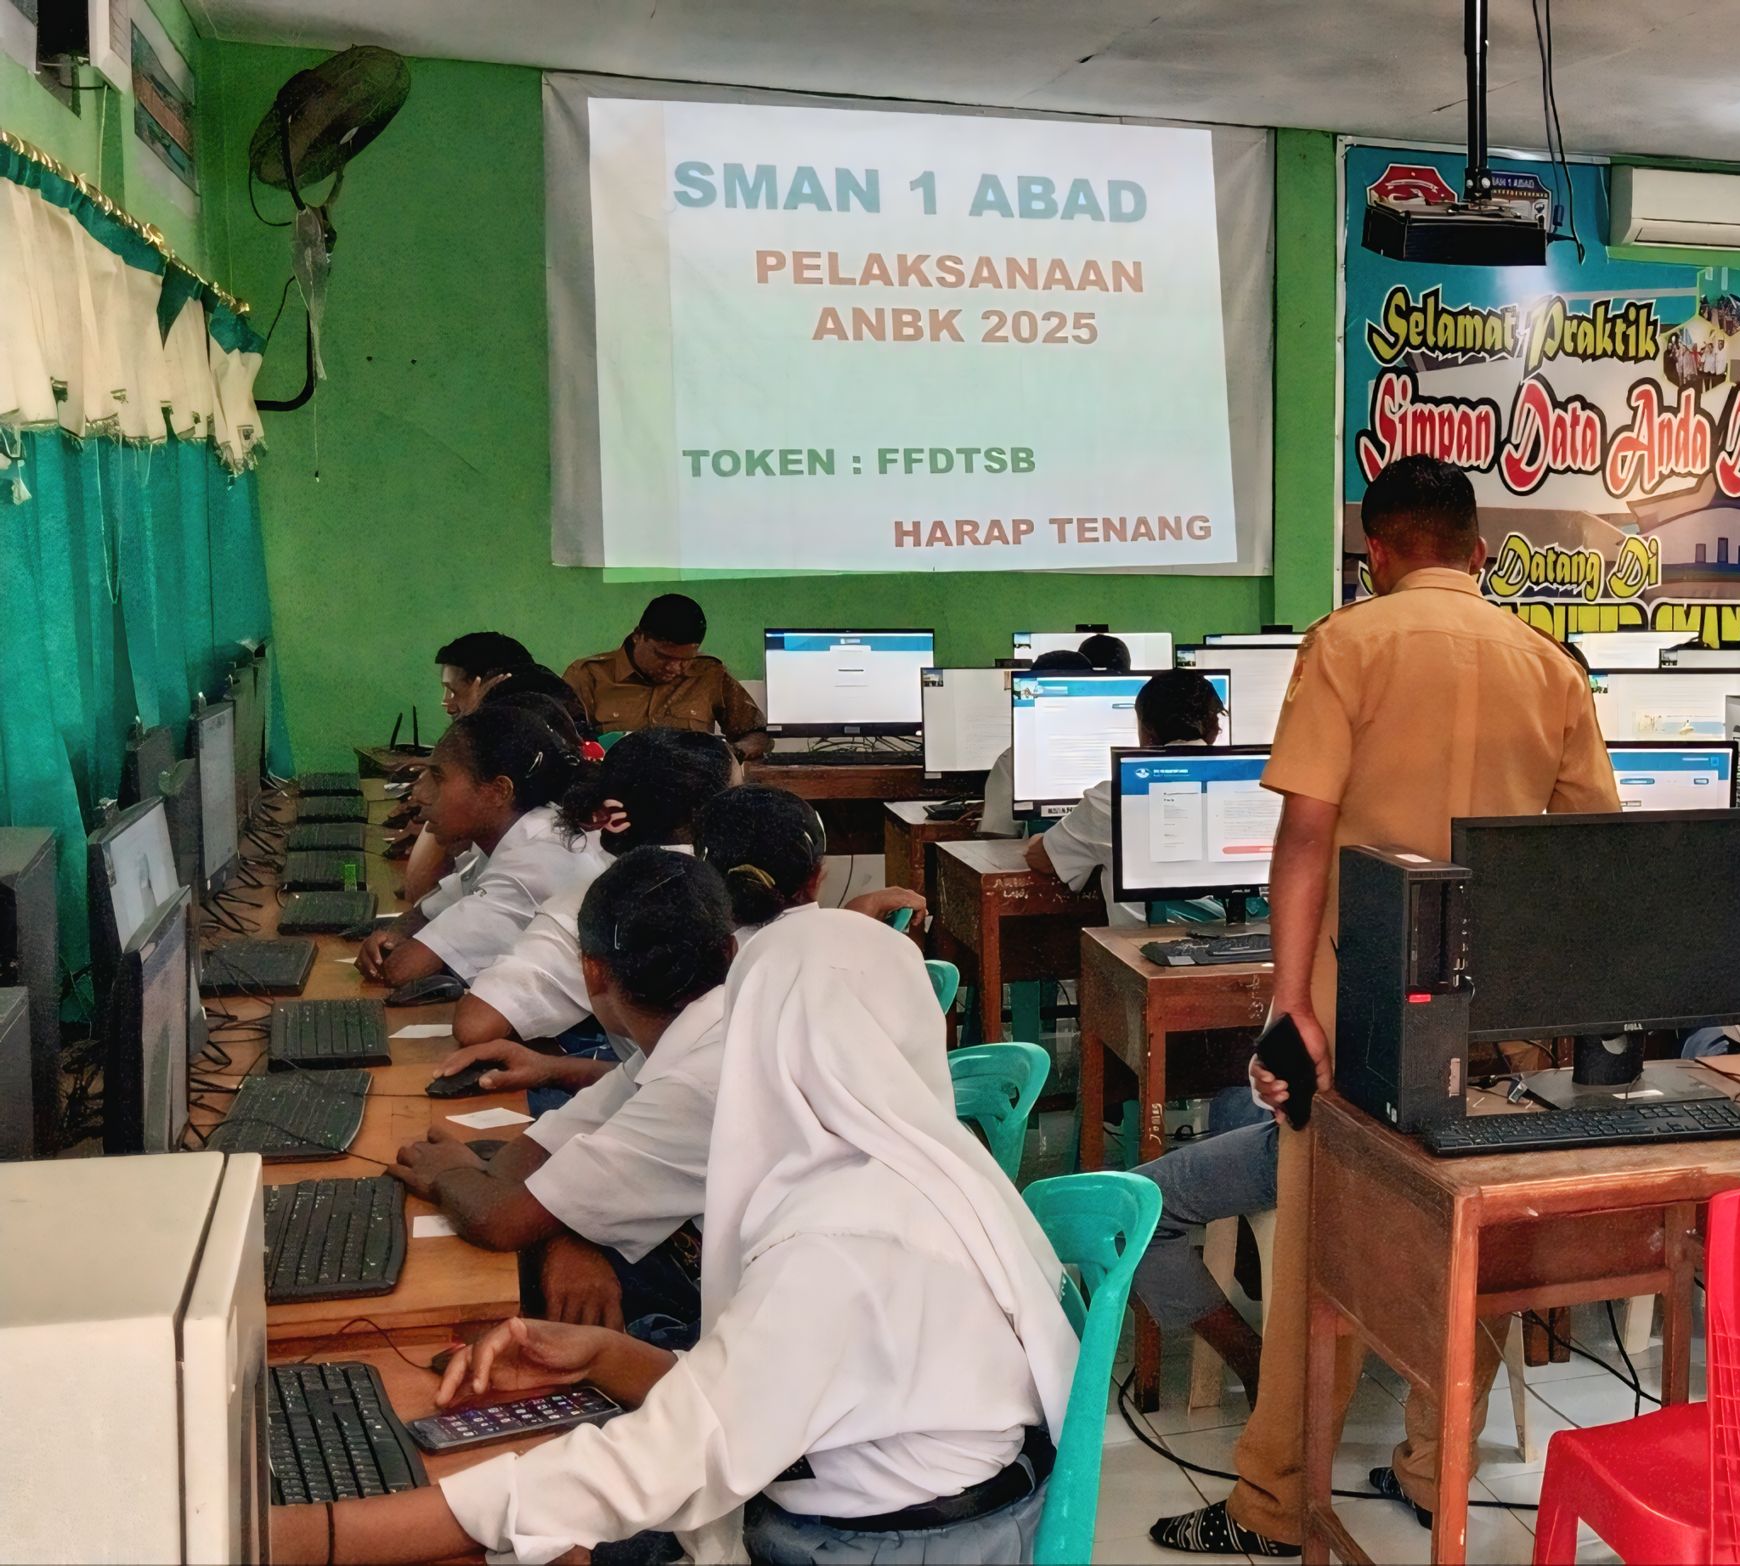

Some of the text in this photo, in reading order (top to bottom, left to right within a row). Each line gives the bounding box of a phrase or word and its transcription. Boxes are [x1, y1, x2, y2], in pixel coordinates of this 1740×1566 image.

[674, 161, 1148, 223] SMAN 1 ABAD
[754, 249, 1144, 294] PELAKSANAAN
[811, 307, 1099, 345] ANBK 2025
[1369, 287, 1660, 377] Selamat Praktik
[1358, 370, 1498, 482] Simpan
[1499, 376, 1604, 493] Data
[1605, 378, 1713, 497] Anda
[682, 447, 1036, 479] TOKEN : FFDTSB
[893, 515, 1213, 550] HARAP TENANG
[1488, 533, 1661, 601] Datang Di
